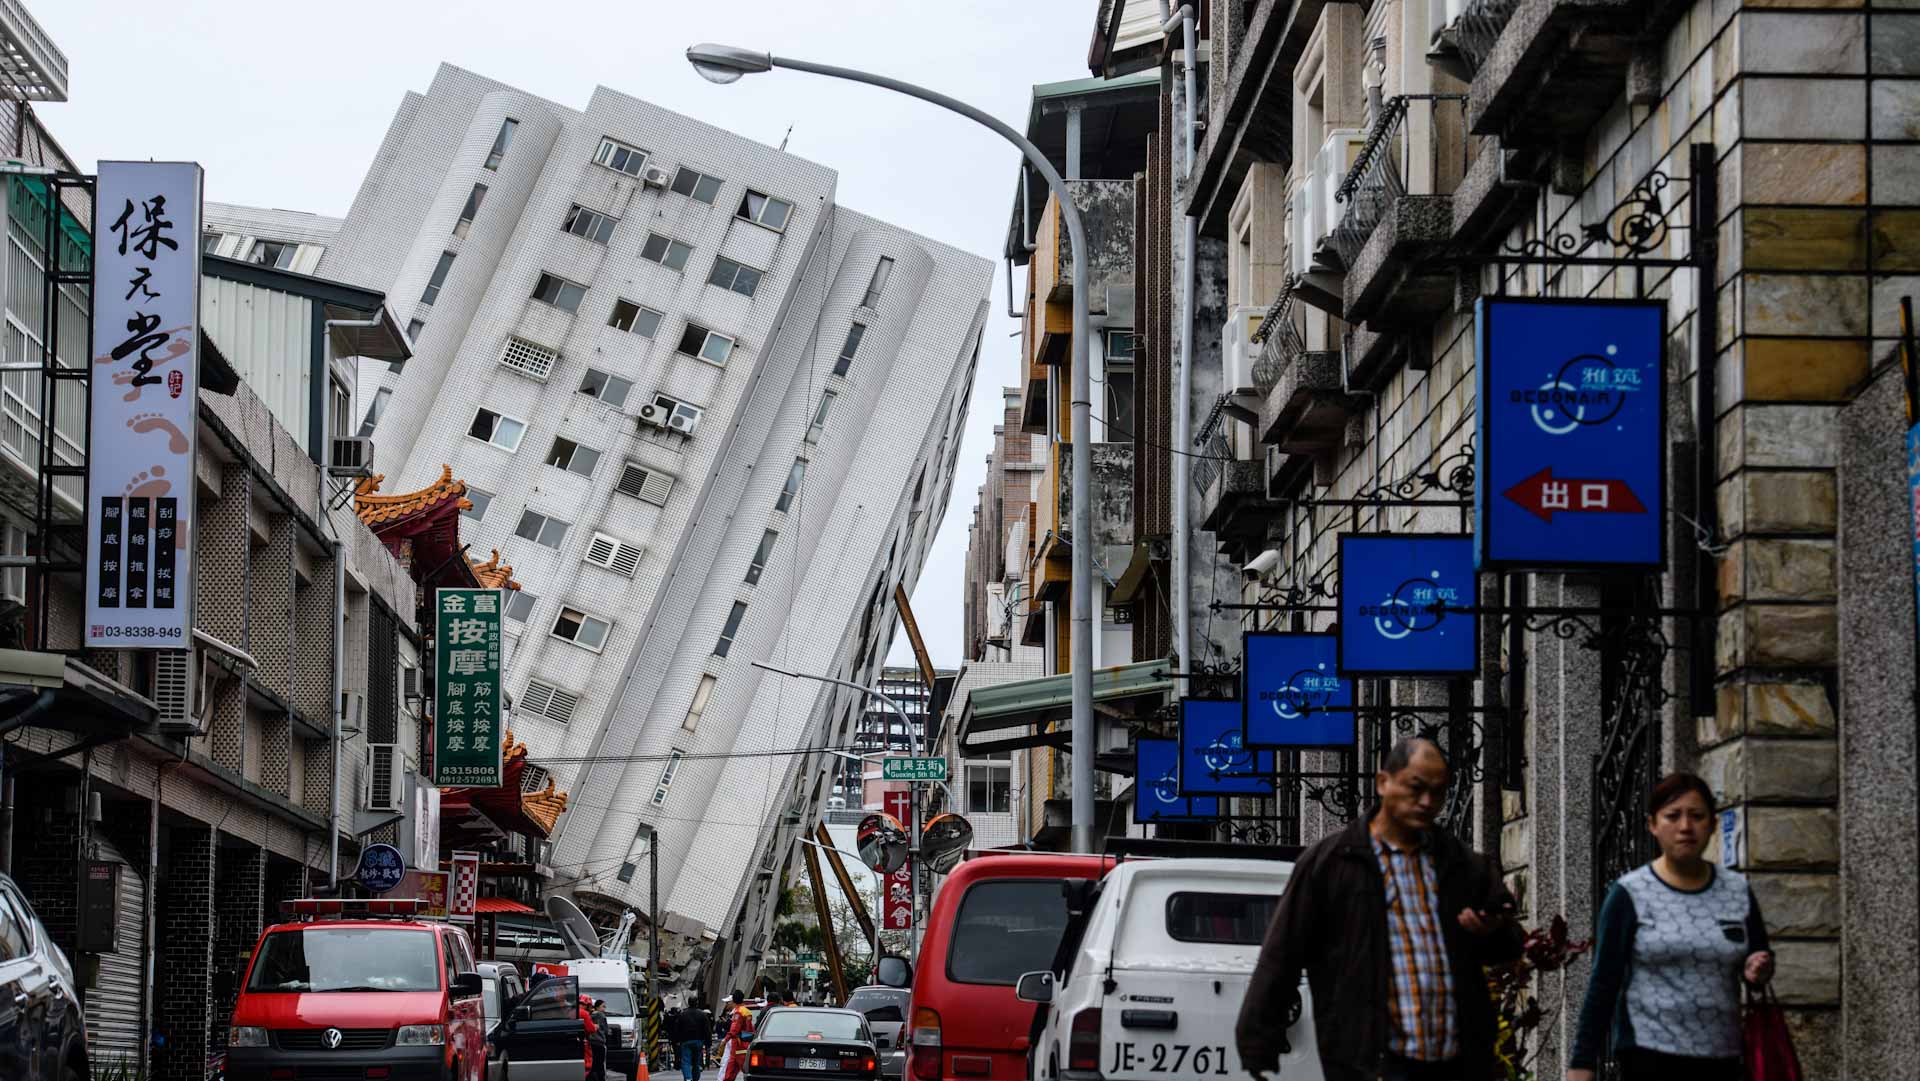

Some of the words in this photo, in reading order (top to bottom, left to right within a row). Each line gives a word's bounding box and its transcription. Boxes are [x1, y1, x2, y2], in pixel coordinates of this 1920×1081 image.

[109, 194, 179, 388] 保元堂
[1541, 481, 1609, 509] 出口
[102, 506, 120, 599] 腳底按摩
[129, 507, 147, 600] 經絡推拿
[105, 626, 182, 638] 03-8338-949
[448, 618, 488, 676] 按摩
[446, 681, 467, 752] 腳底按摩
[472, 681, 492, 752] 筋穴按摩
[442, 766, 496, 775] 8315806
[1110, 1041, 1229, 1075] JE-2761
